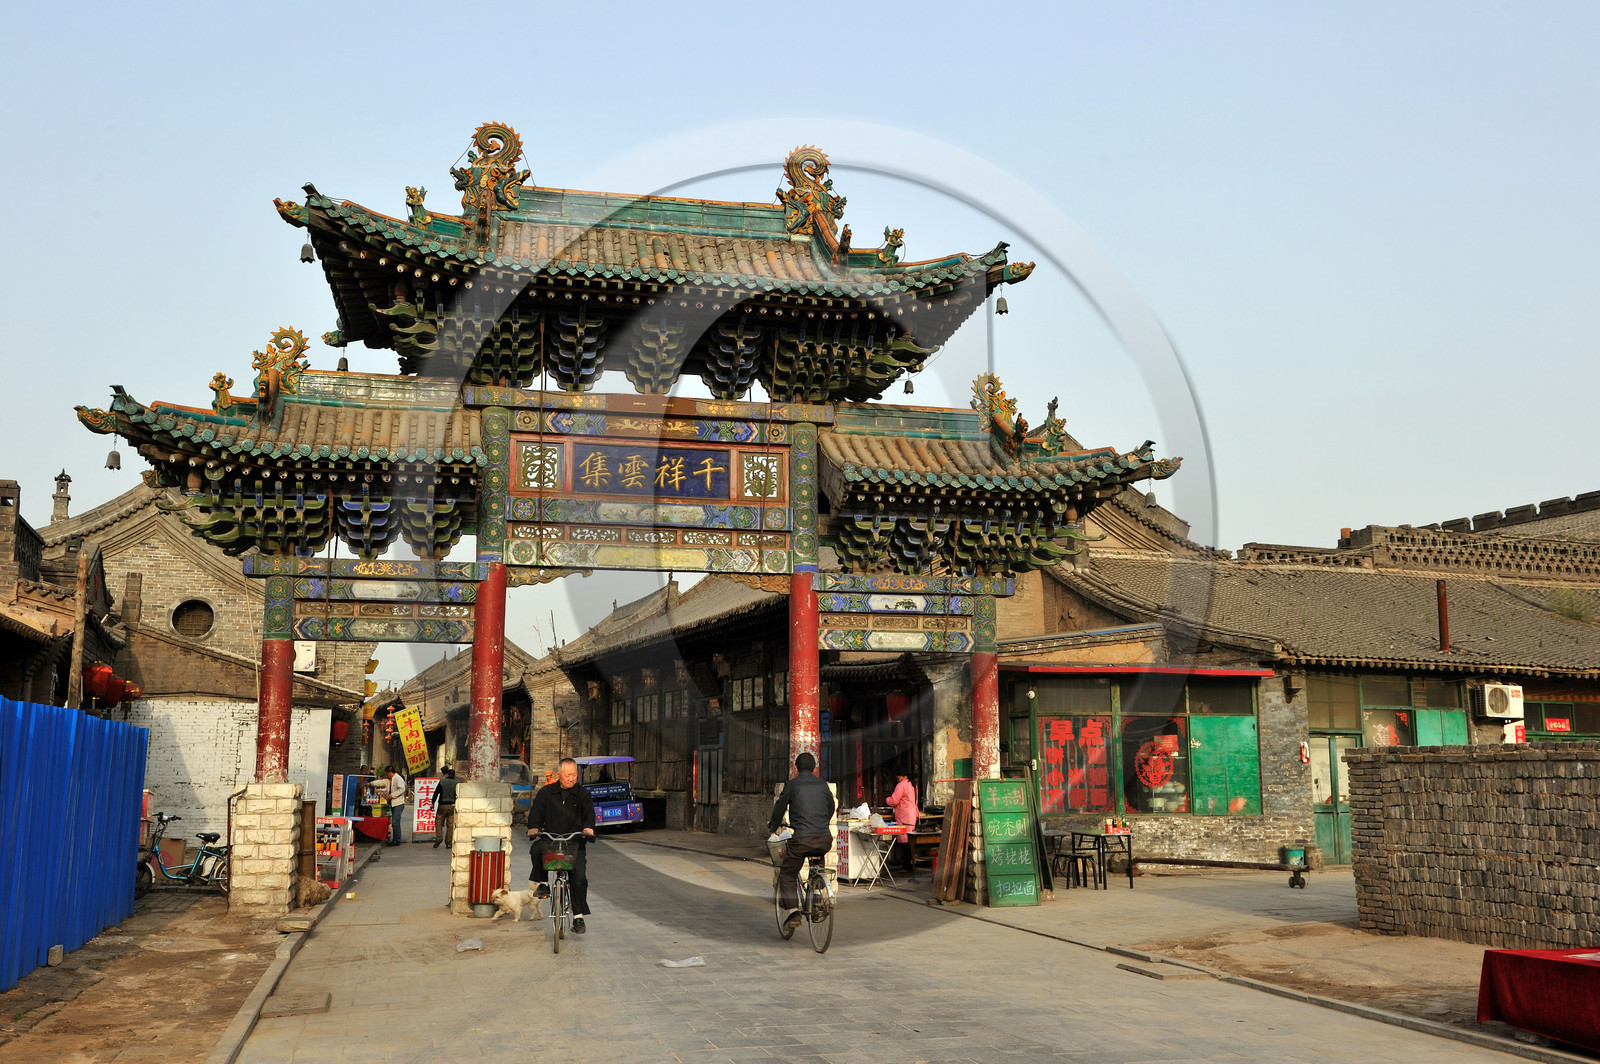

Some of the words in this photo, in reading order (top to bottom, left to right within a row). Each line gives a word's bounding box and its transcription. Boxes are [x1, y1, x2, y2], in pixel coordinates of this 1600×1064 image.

[400, 717, 427, 765] 牛肉陈醋
[1049, 718, 1104, 746] 早点
[1046, 767, 1107, 786] 小米粥
[1047, 788, 1108, 806] 方便面
[416, 785, 436, 832] 牛肉陈醋
[987, 817, 1026, 837] 碗秃则
[995, 879, 1035, 898] 担担面
